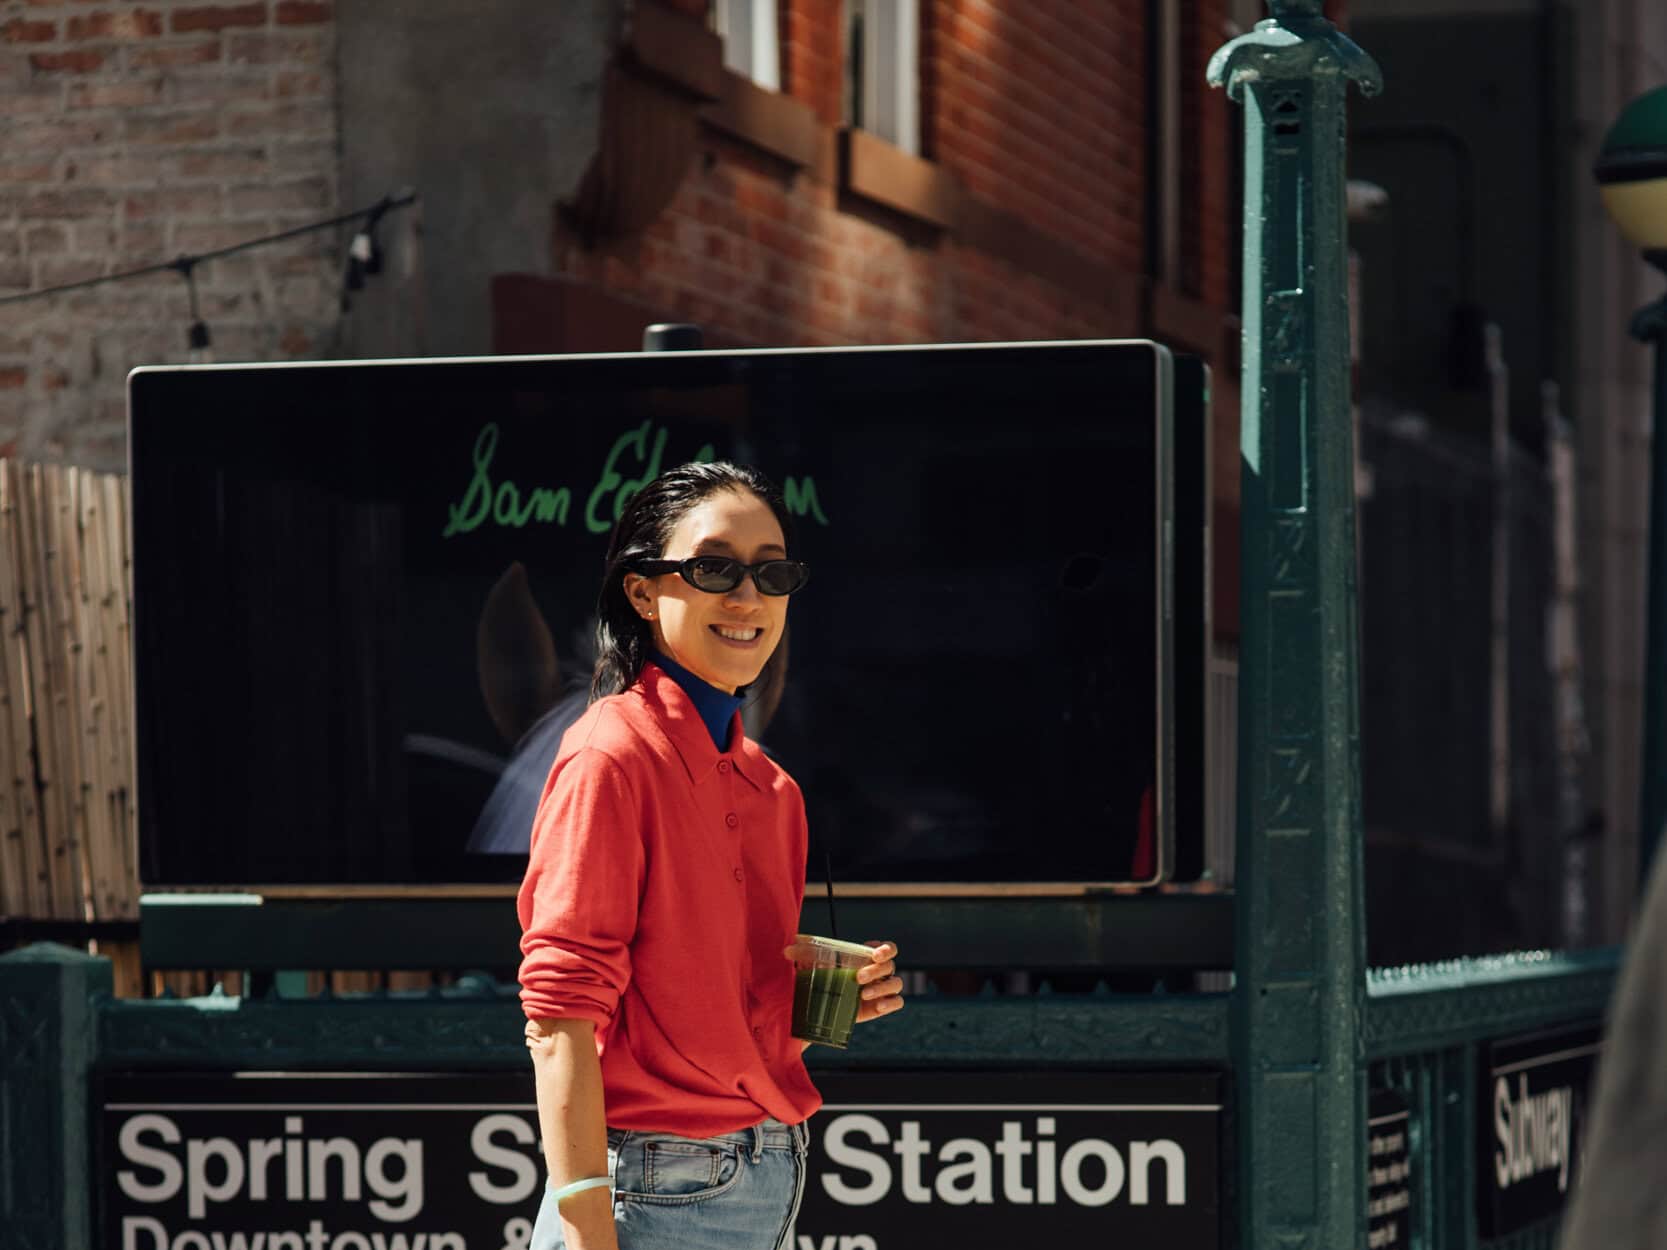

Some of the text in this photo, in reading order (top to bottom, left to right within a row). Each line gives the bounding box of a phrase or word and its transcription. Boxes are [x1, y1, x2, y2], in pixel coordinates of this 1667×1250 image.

[443, 421, 572, 538] Sam
[116, 1113, 1187, 1222] Spring S Station
